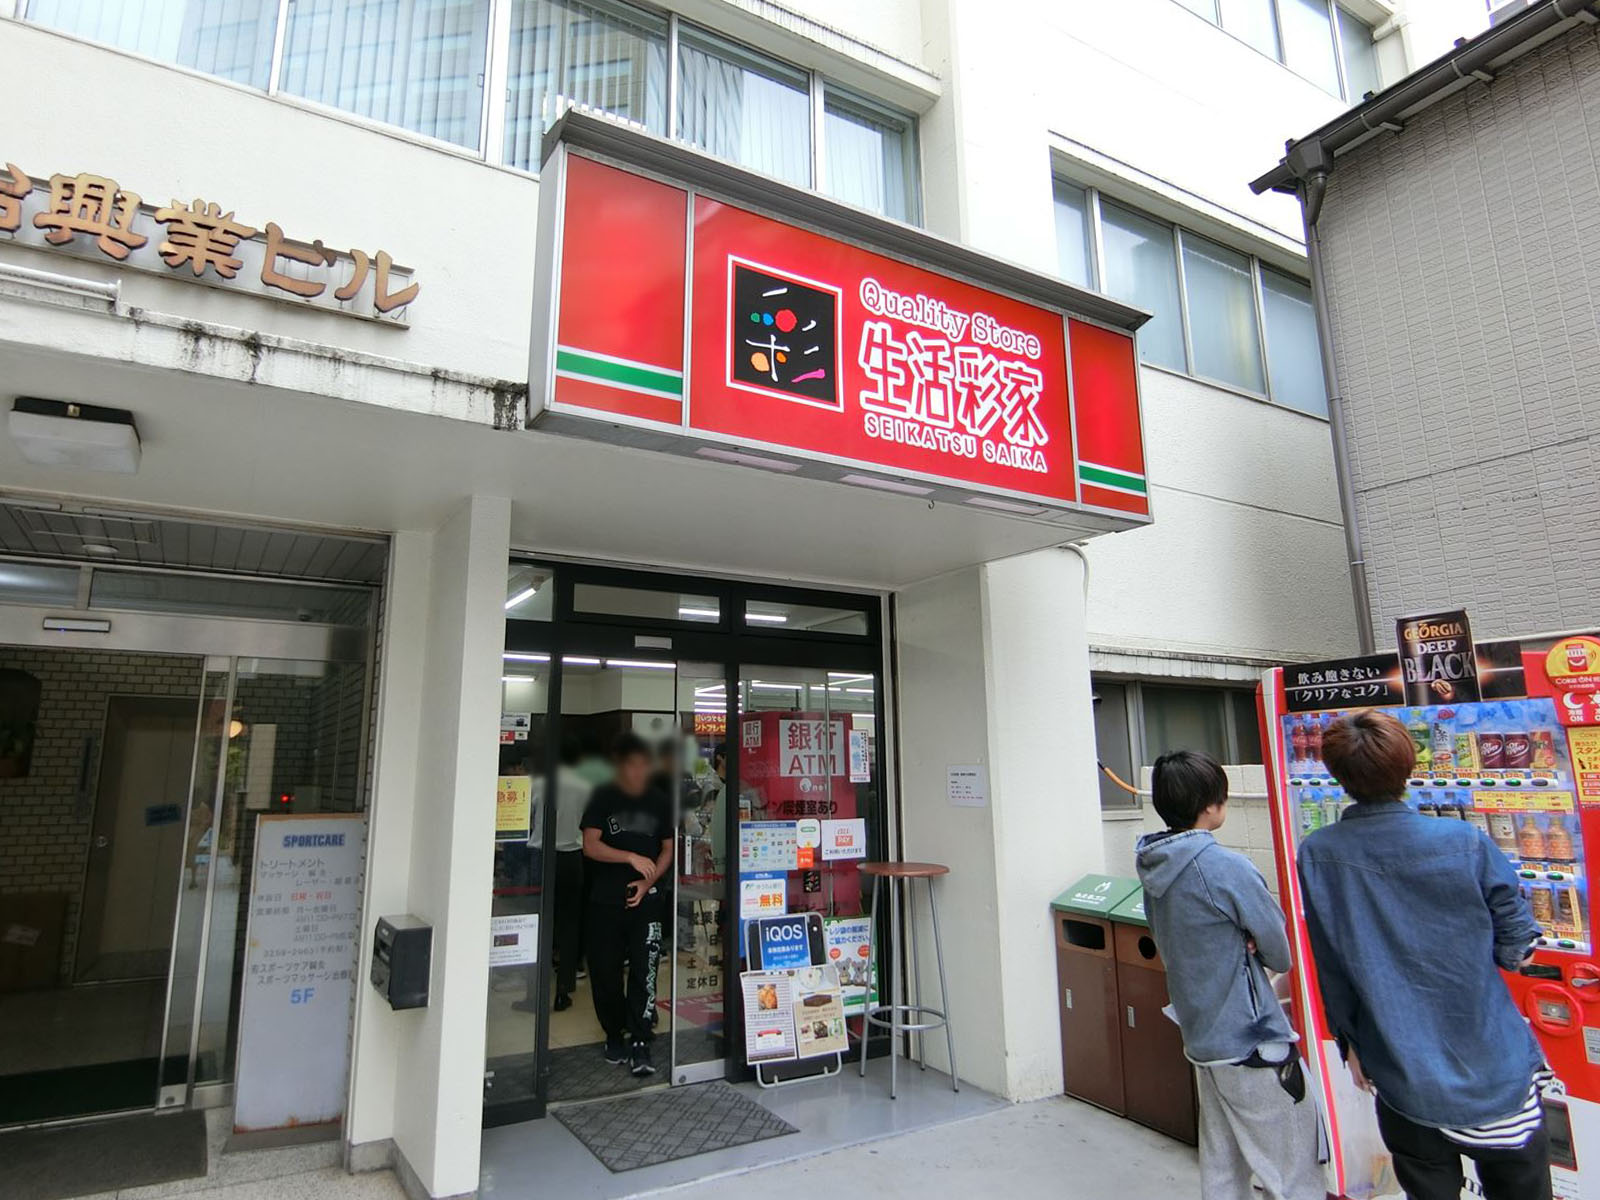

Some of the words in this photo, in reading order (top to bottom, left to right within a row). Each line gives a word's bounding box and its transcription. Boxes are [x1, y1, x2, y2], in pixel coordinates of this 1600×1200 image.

[859, 277, 970, 343] Quality
[971, 312, 1041, 360] Store
[859, 321, 1048, 446] 生活彩家
[864, 413, 978, 458] SEIKATSU
[983, 438, 1048, 474] SAIKA
[1404, 623, 1462, 640] GEORGIA
[1417, 639, 1457, 655] DEEP
[1298, 667, 1380, 685] 飲み飽きない
[1404, 652, 1475, 683] BLACK
[788, 722, 837, 751] 銀行
[788, 754, 837, 775] ATM
[283, 834, 345, 848] SPORTCARE
[765, 924, 803, 942] iQOS
[687, 975, 718, 990] 定休日
[290, 988, 314, 1004] 5F
